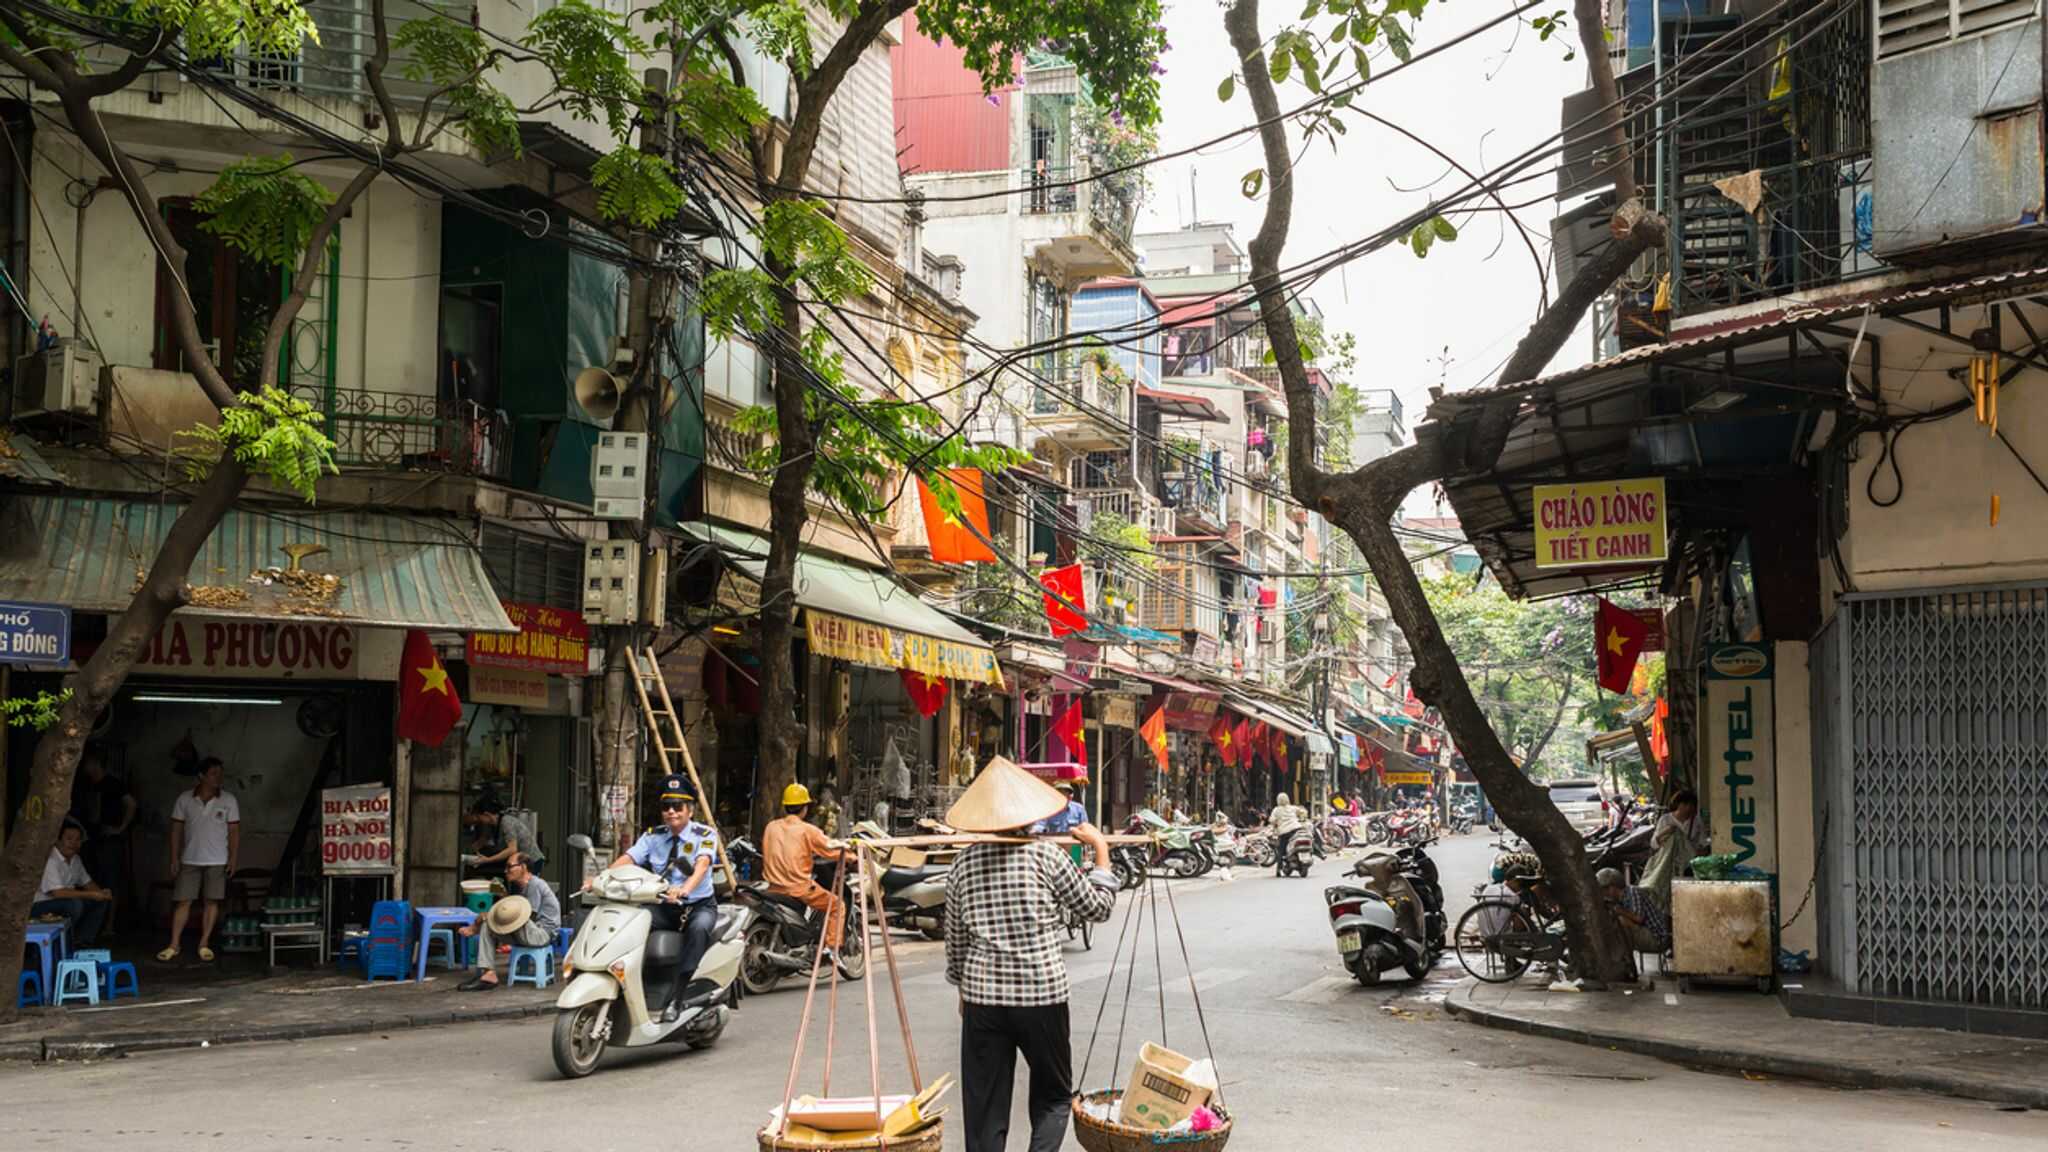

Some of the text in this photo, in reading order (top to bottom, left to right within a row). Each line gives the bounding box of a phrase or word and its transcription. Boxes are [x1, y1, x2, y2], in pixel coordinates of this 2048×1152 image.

[1541, 486, 1656, 529] CHÁO LÒNG
[1549, 531, 1650, 561] TIẾT CANH
[324, 800, 355, 814] BIA
[324, 818, 385, 839] HÀ NỘI
